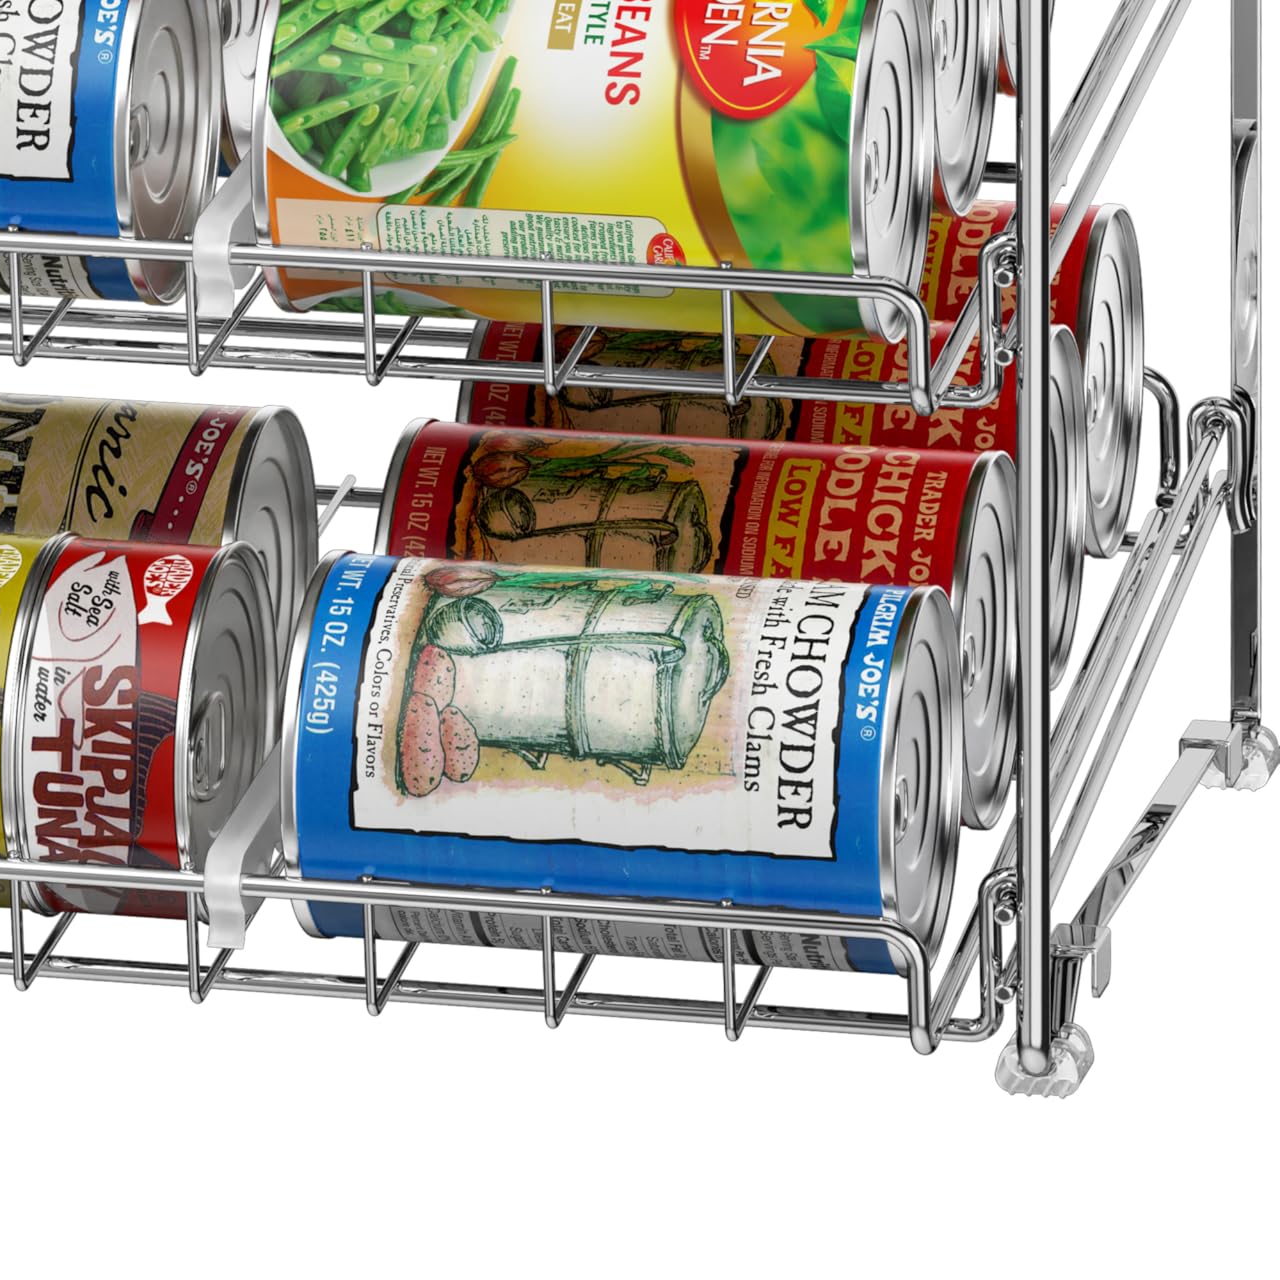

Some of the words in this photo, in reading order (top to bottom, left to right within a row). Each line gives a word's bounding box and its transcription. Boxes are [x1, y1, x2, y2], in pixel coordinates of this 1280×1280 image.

[554, 3, 576, 33] EAT
[913, 470, 947, 540] TRADER
[64, 582, 91, 617] Salt
[102, 571, 121, 596] with
[328, 597, 355, 616] 15
[85, 596, 113, 627] Sea
[321, 622, 349, 652] OZ.
[378, 579, 413, 644] Preservatives,
[763, 595, 794, 627] with
[866, 588, 906, 647] PILGRIM
[54, 667, 71, 685] in
[371, 649, 393, 698] Colors
[751, 634, 787, 696] Fresh
[33, 667, 52, 722] water
[305, 662, 340, 734] (425g)
[369, 702, 379, 718] or
[777, 614, 834, 829] CHOWDER
[365, 722, 383, 779] Flavors
[744, 706, 776, 792] Clams
[31, 718, 85, 863] TUNA
